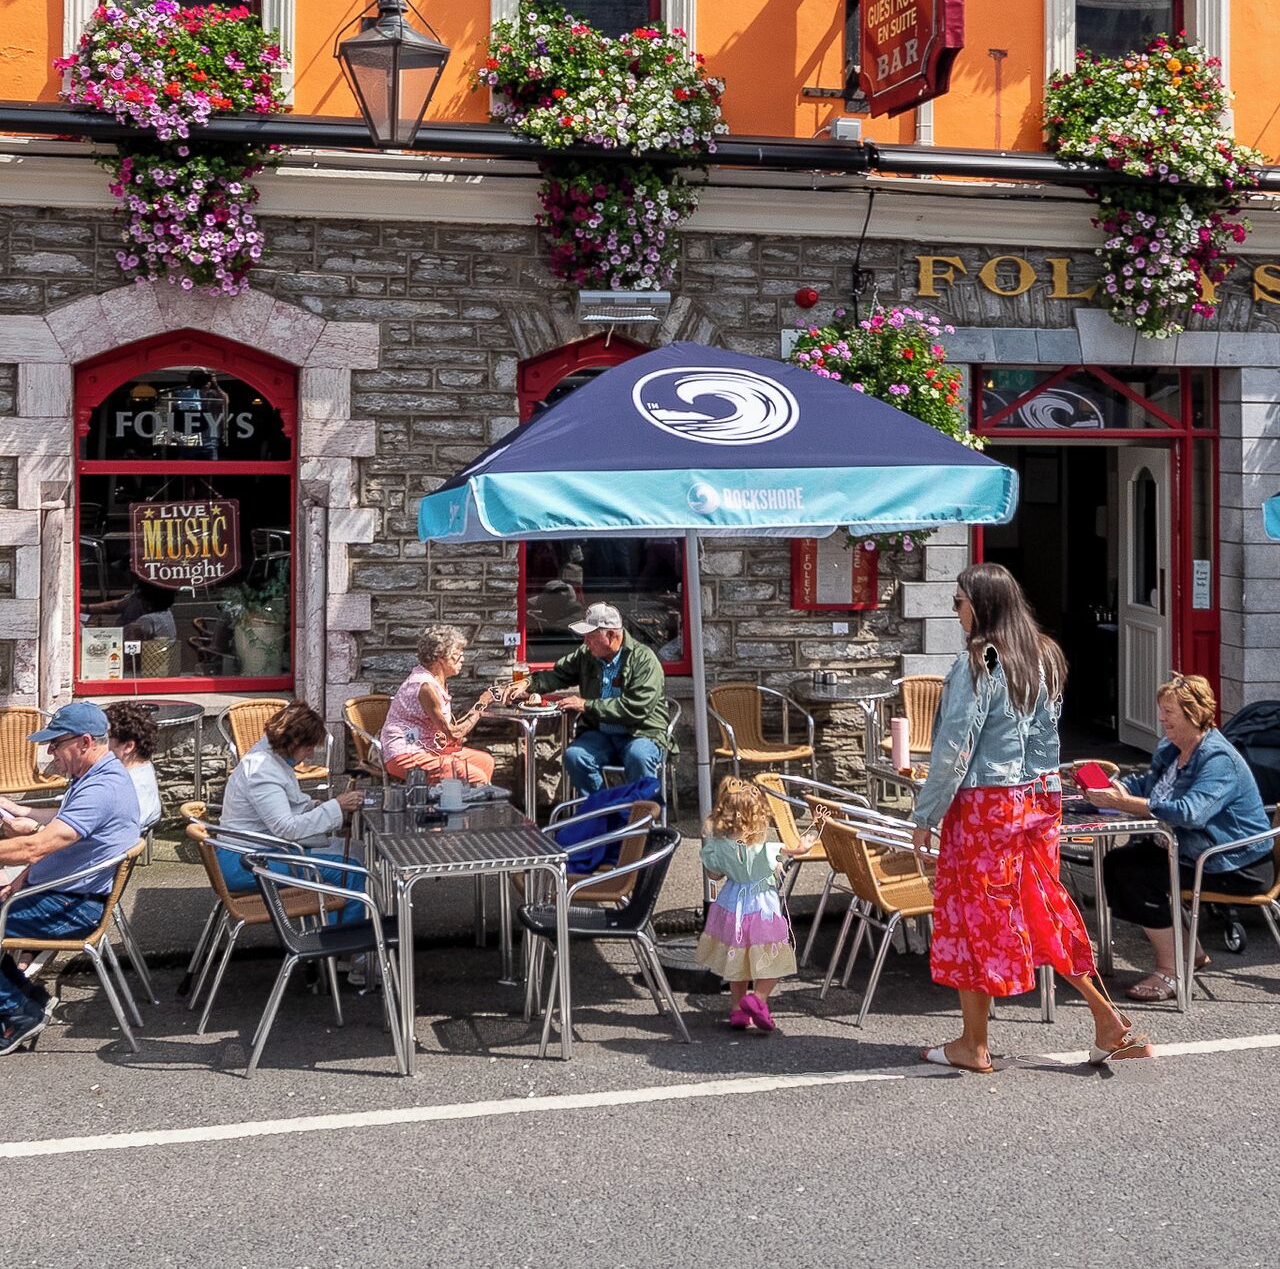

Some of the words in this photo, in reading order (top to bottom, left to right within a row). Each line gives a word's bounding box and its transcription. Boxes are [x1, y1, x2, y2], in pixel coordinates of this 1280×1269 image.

[877, 24, 889, 46] EN
[890, 6, 918, 39] SUITE
[876, 37, 919, 81] BAR
[160, 505, 207, 519] LIVE
[723, 487, 805, 510] ROCKSHORE
[141, 515, 229, 561] MUSIC
[144, 559, 225, 584] Tonight
